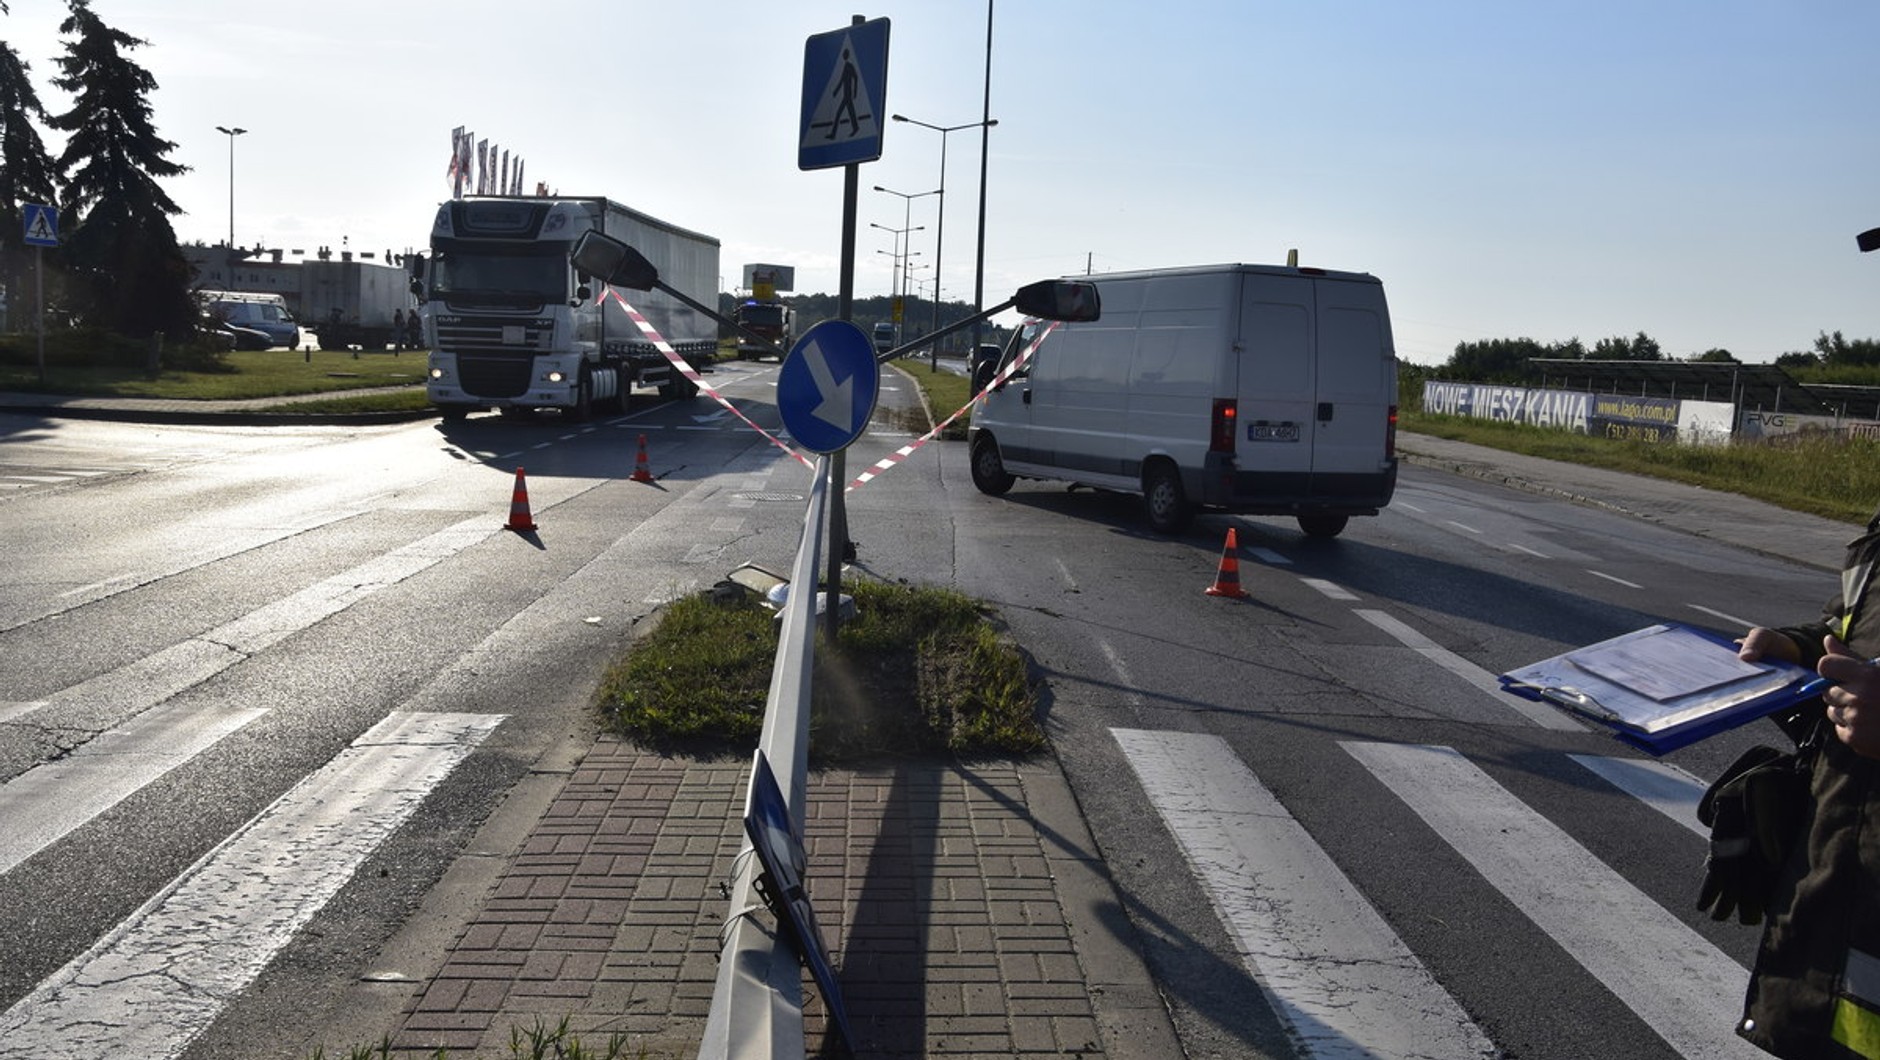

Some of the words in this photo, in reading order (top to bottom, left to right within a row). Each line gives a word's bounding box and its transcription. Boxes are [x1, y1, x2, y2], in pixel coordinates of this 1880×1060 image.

[1424, 384, 1468, 416] NOWE
[1472, 387, 1589, 436] MIESZKANIA
[1597, 400, 1677, 423] www.lago.com.pl
[1848, 423, 1880, 441] FOTO
